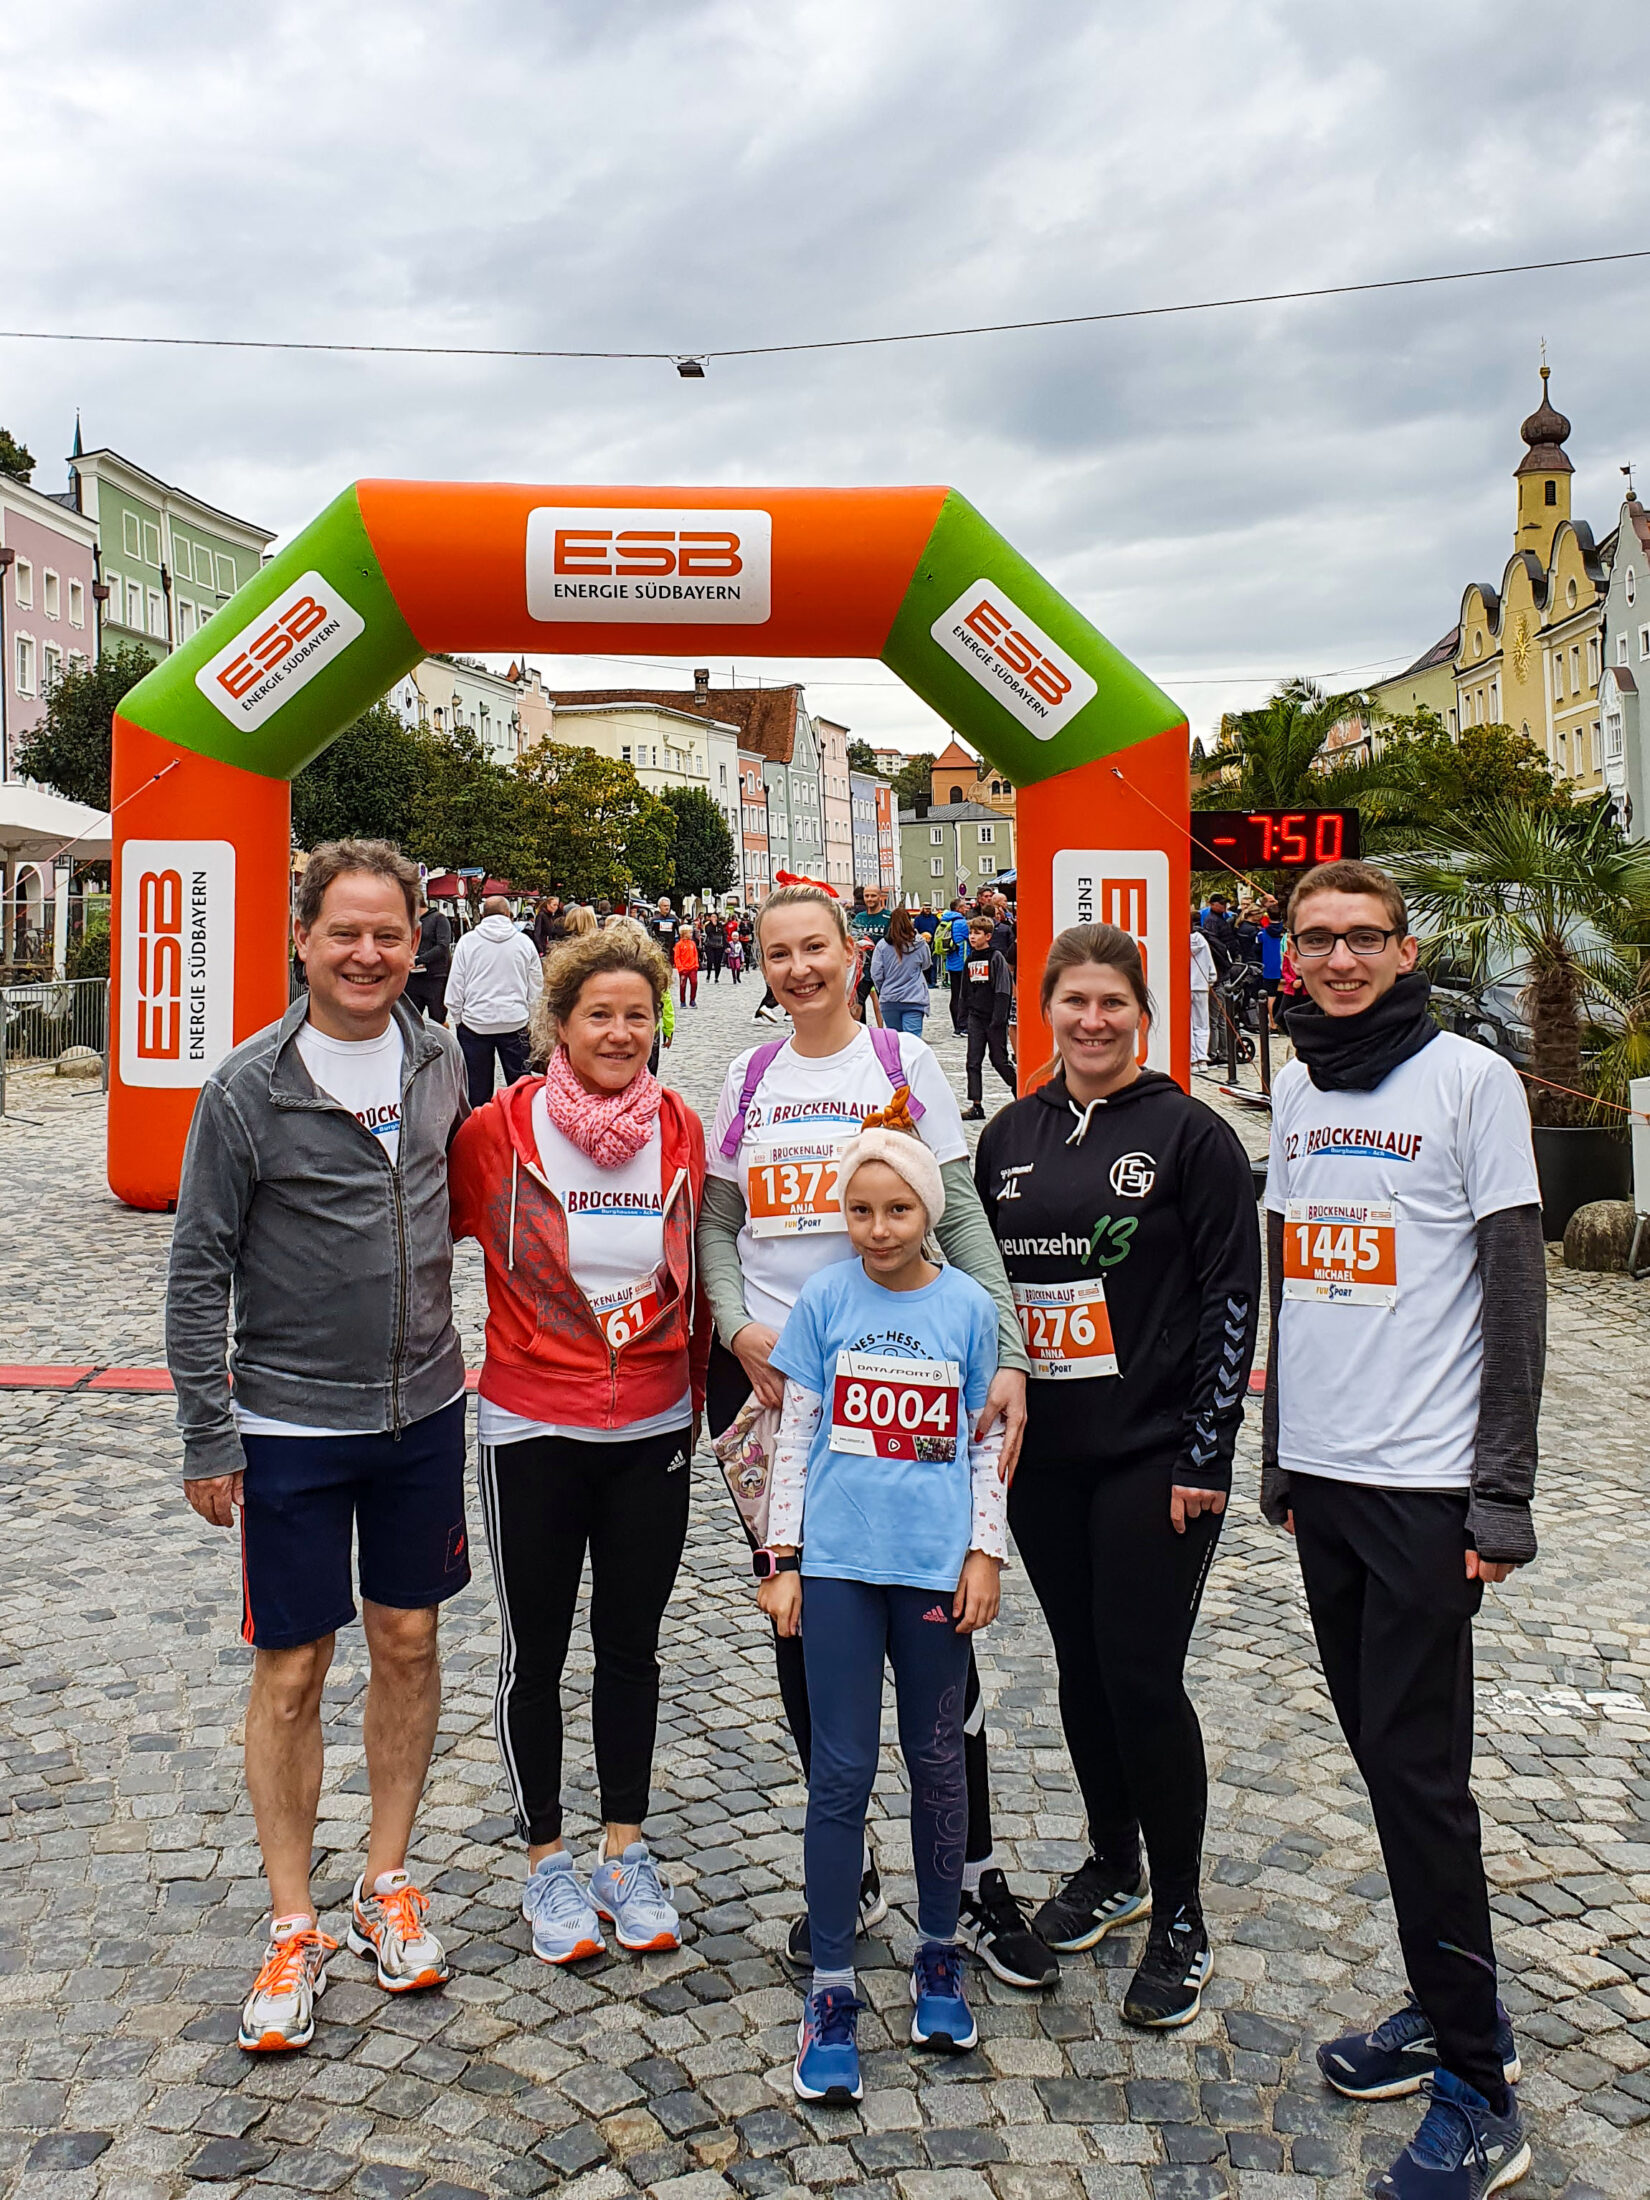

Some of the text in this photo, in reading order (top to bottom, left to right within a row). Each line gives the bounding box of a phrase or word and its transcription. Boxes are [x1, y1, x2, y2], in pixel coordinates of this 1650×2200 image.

[554, 529, 743, 577] ESB
[554, 582, 741, 600] ENERGIE SÜDBAYERN
[216, 596, 327, 699] ESB
[241, 619, 341, 711] ENERGIE SÜDBAYERN
[963, 599, 1072, 706] ESB
[952, 625, 1049, 718] ENERGIE SÜDBAYERN
[1248, 814, 1343, 862] 7:50
[1078, 877, 1093, 926] ENER
[137, 869, 182, 1060] ESB
[188, 871, 207, 1060] ENERGIE SÜDBAYERN
[773, 1145, 833, 1162] BRÜCKENLAUF
[1307, 1126, 1422, 1161] BRÜCKENLAUF
[568, 1191, 663, 1213] BRÜCKENLA
[761, 1162, 840, 1205] 1372
[996, 1177, 1021, 1200] AL
[790, 1203, 815, 1214] ANJA
[1308, 1205, 1368, 1222] BRÜCKENLAUF
[1296, 1225, 1380, 1271] 1445
[1314, 1268, 1355, 1282] MICHAEL
[1019, 1306, 1096, 1347] 1276
[857, 1364, 931, 1378] DATASPORT
[1040, 1349, 1066, 1359] ANNA
[844, 1383, 951, 1431] 8004
